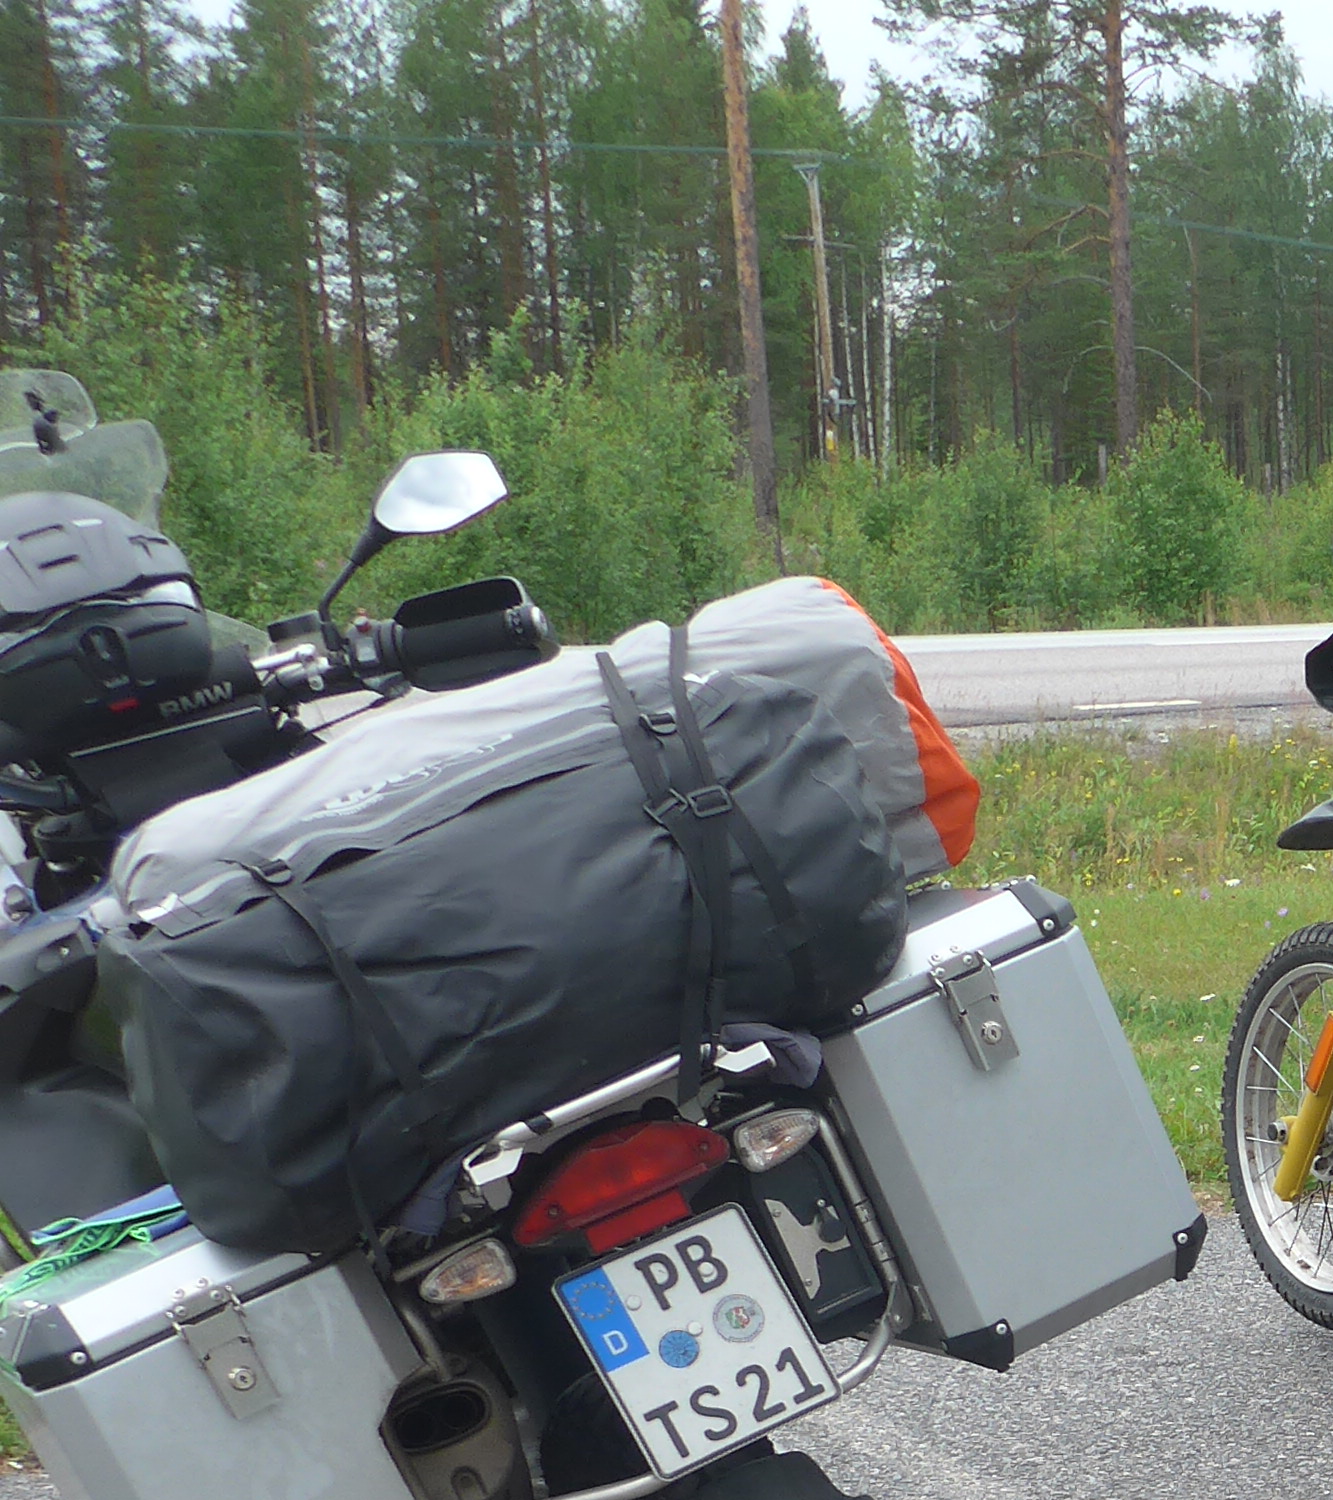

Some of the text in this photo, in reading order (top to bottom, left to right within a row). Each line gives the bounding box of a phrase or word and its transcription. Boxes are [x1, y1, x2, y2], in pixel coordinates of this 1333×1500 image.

[158, 681, 233, 718] BMW
[633, 1234, 729, 1311] PB
[602, 1329, 629, 1356] D
